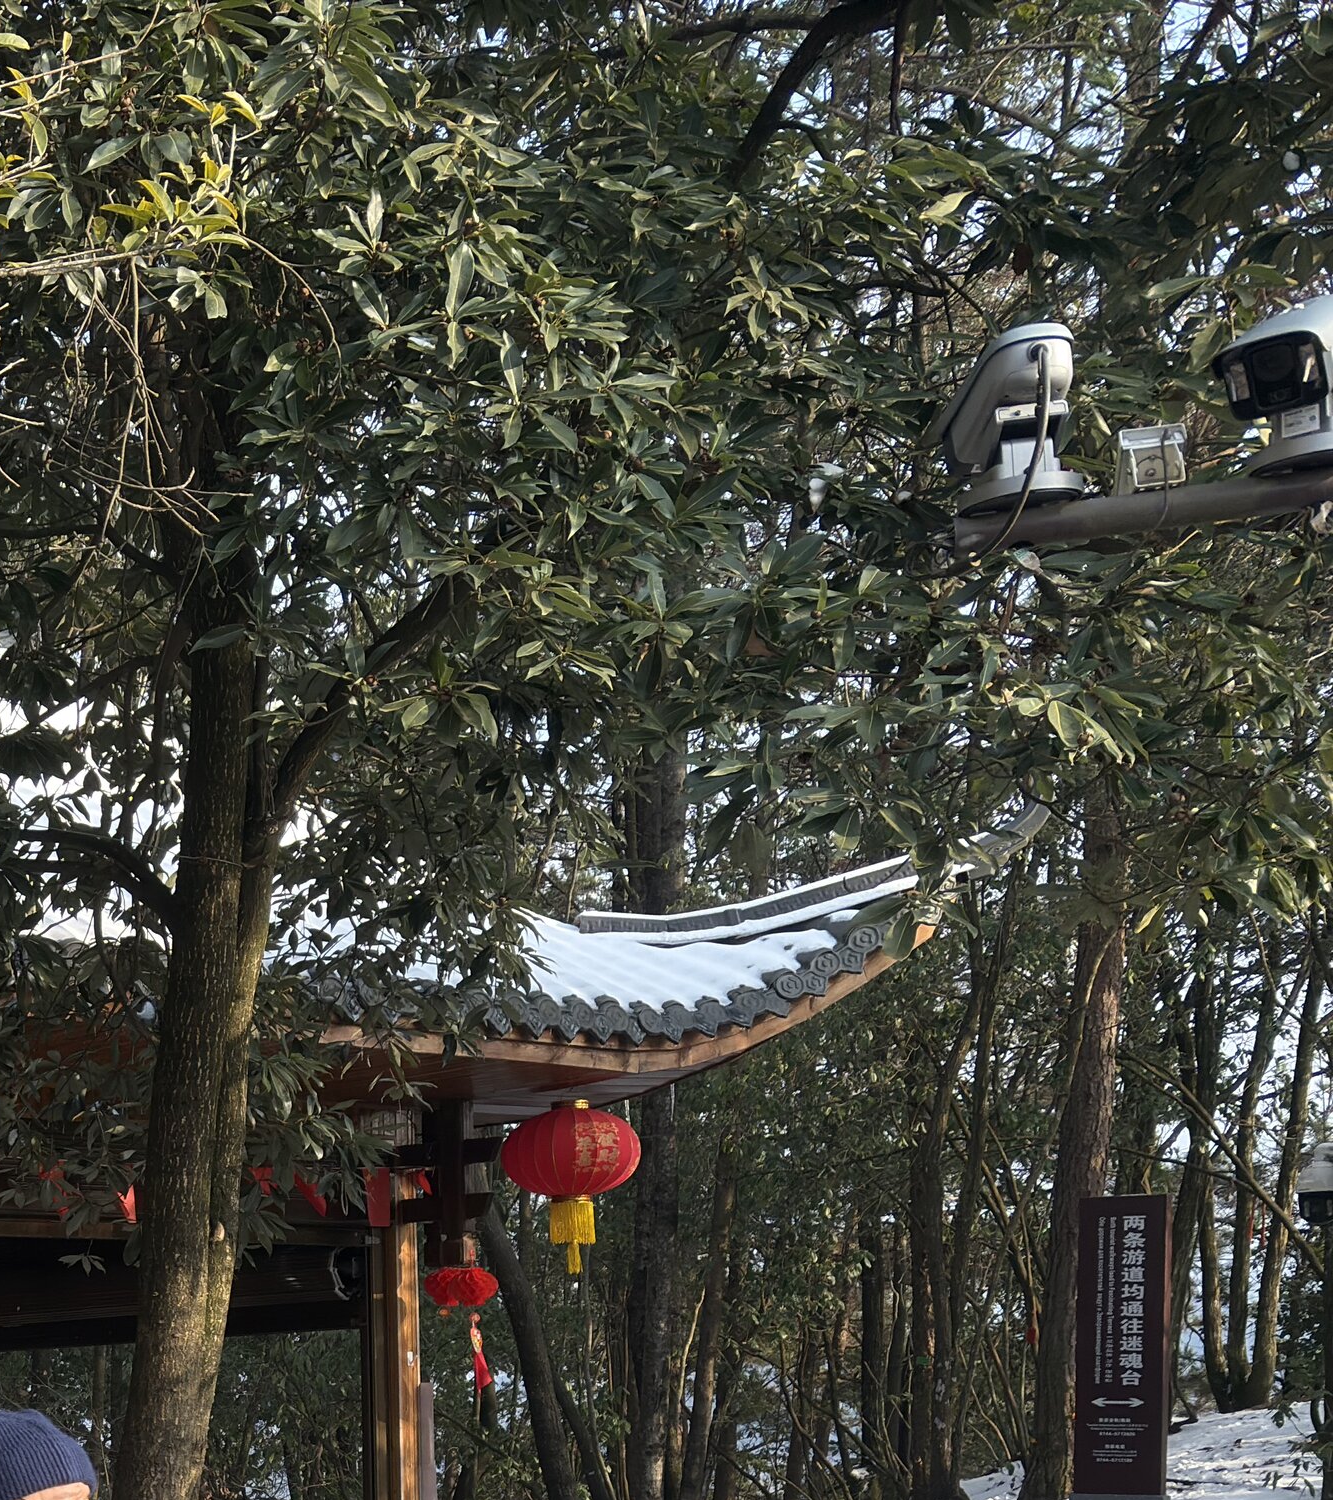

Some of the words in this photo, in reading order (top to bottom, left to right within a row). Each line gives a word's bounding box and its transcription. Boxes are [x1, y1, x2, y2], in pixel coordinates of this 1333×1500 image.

[1119, 1214, 1147, 1387] 两条游道均通往迷魂台
